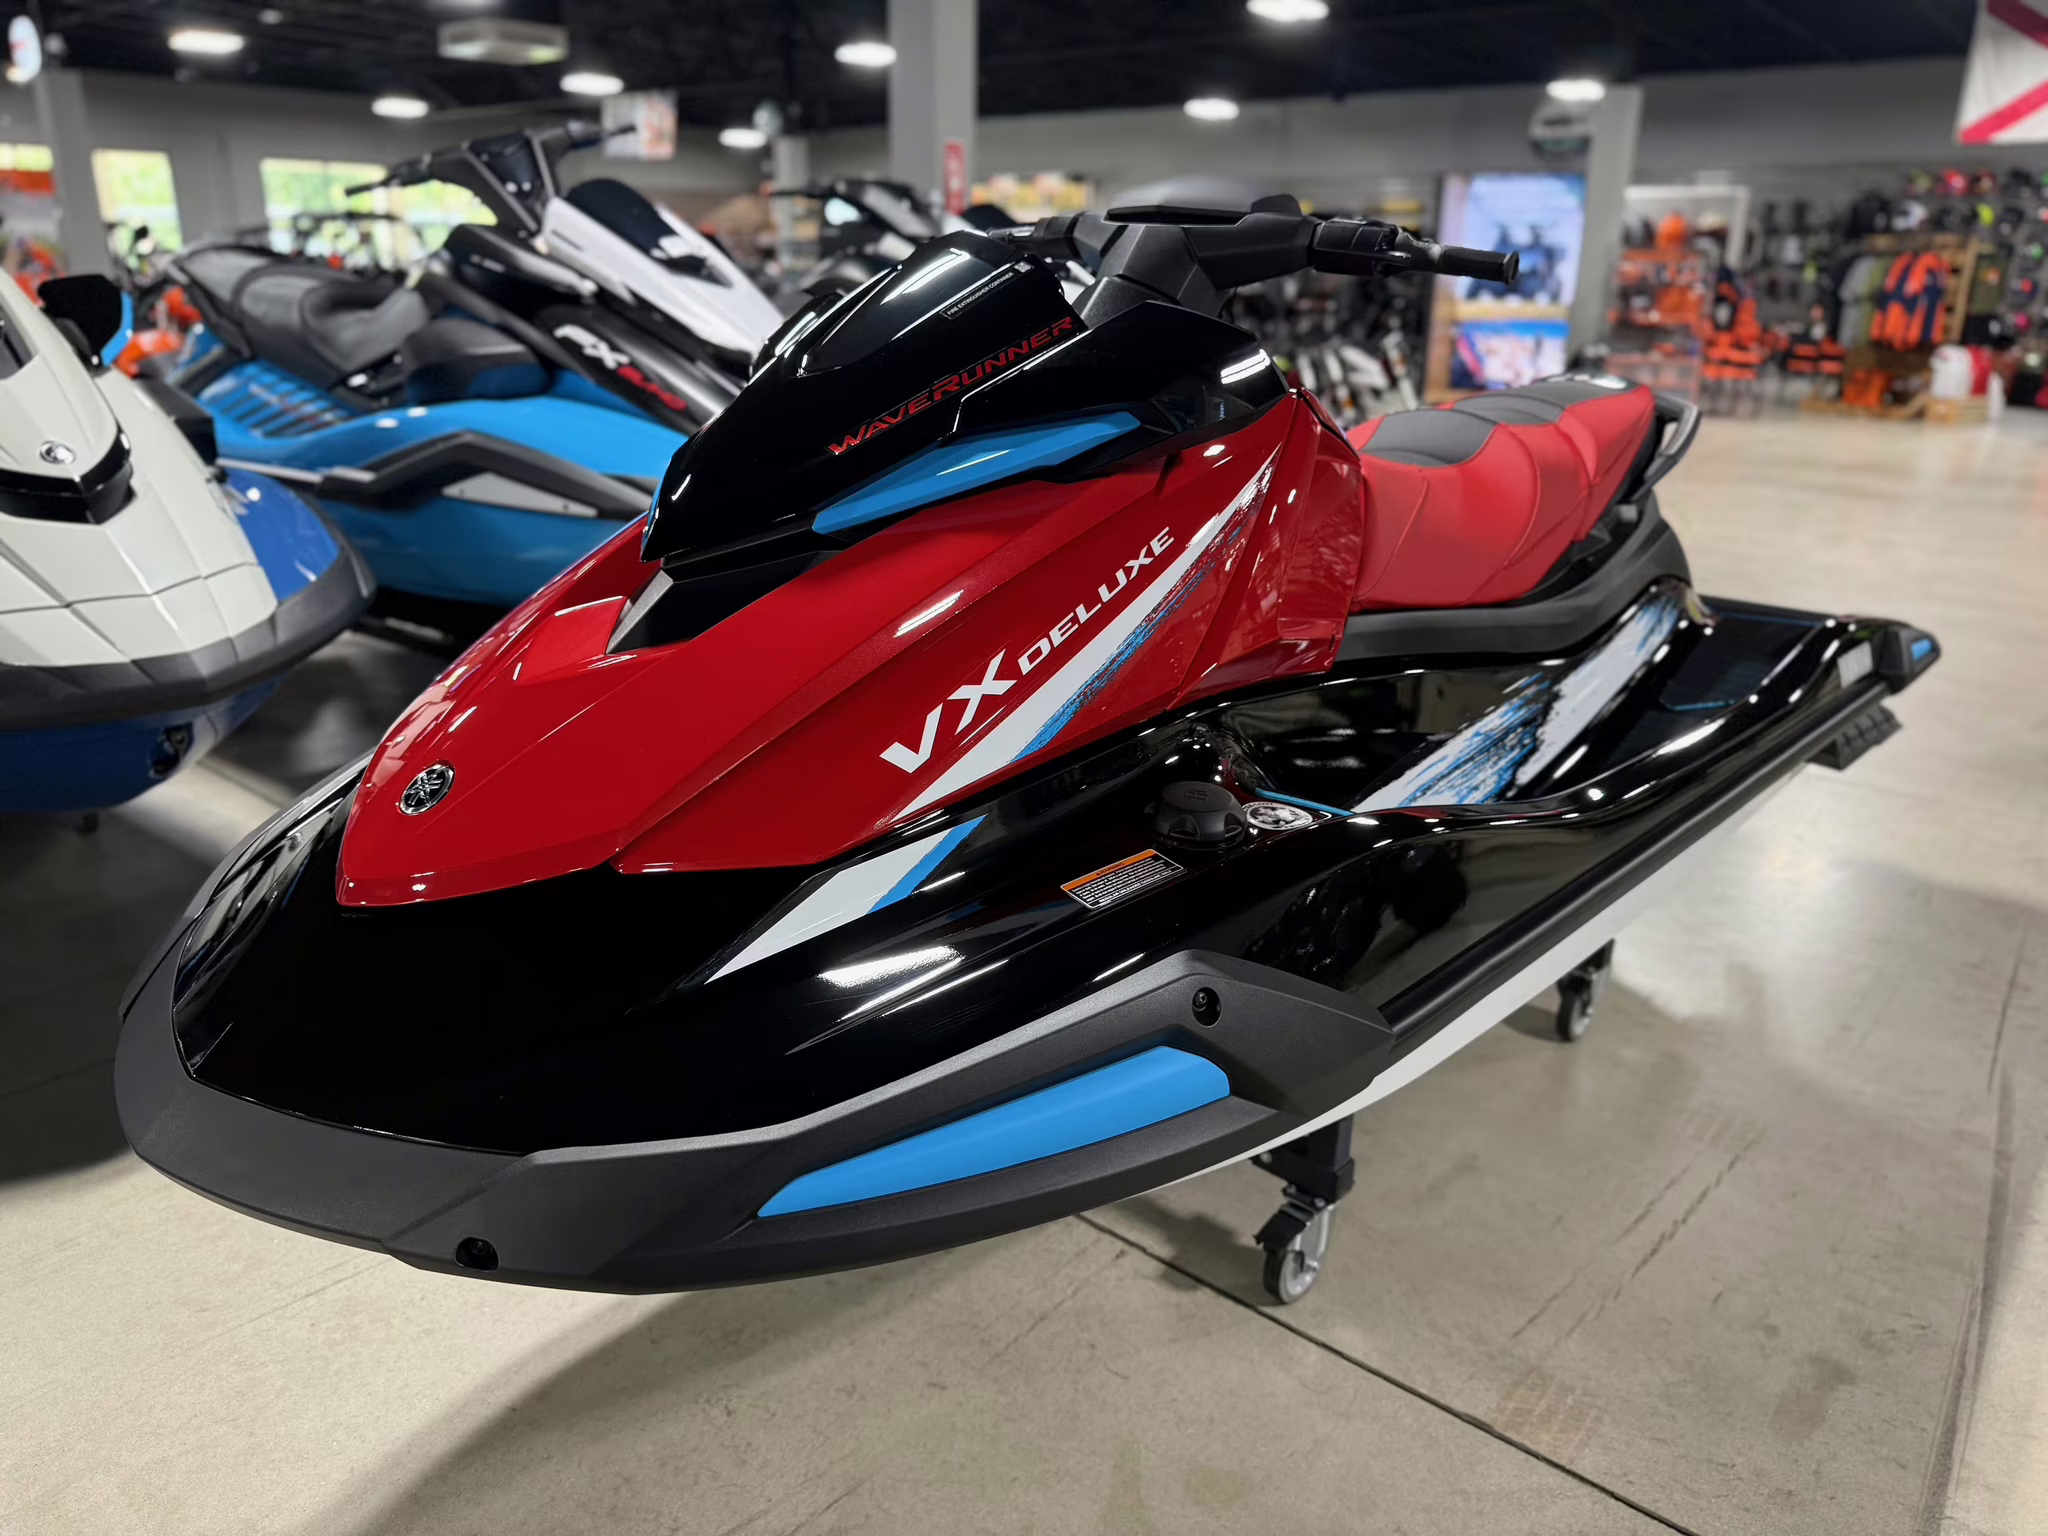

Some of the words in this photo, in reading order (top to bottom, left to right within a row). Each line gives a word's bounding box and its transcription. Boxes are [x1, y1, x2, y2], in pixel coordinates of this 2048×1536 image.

[946, 306, 960, 316] FIRE
[957, 286, 990, 309] EXTINGUISHER
[988, 271, 1015, 289] CONTAINER
[827, 316, 1073, 455] WAVERUNNER
[879, 648, 1018, 774] VX
[1017, 526, 1175, 676] DELUXE
